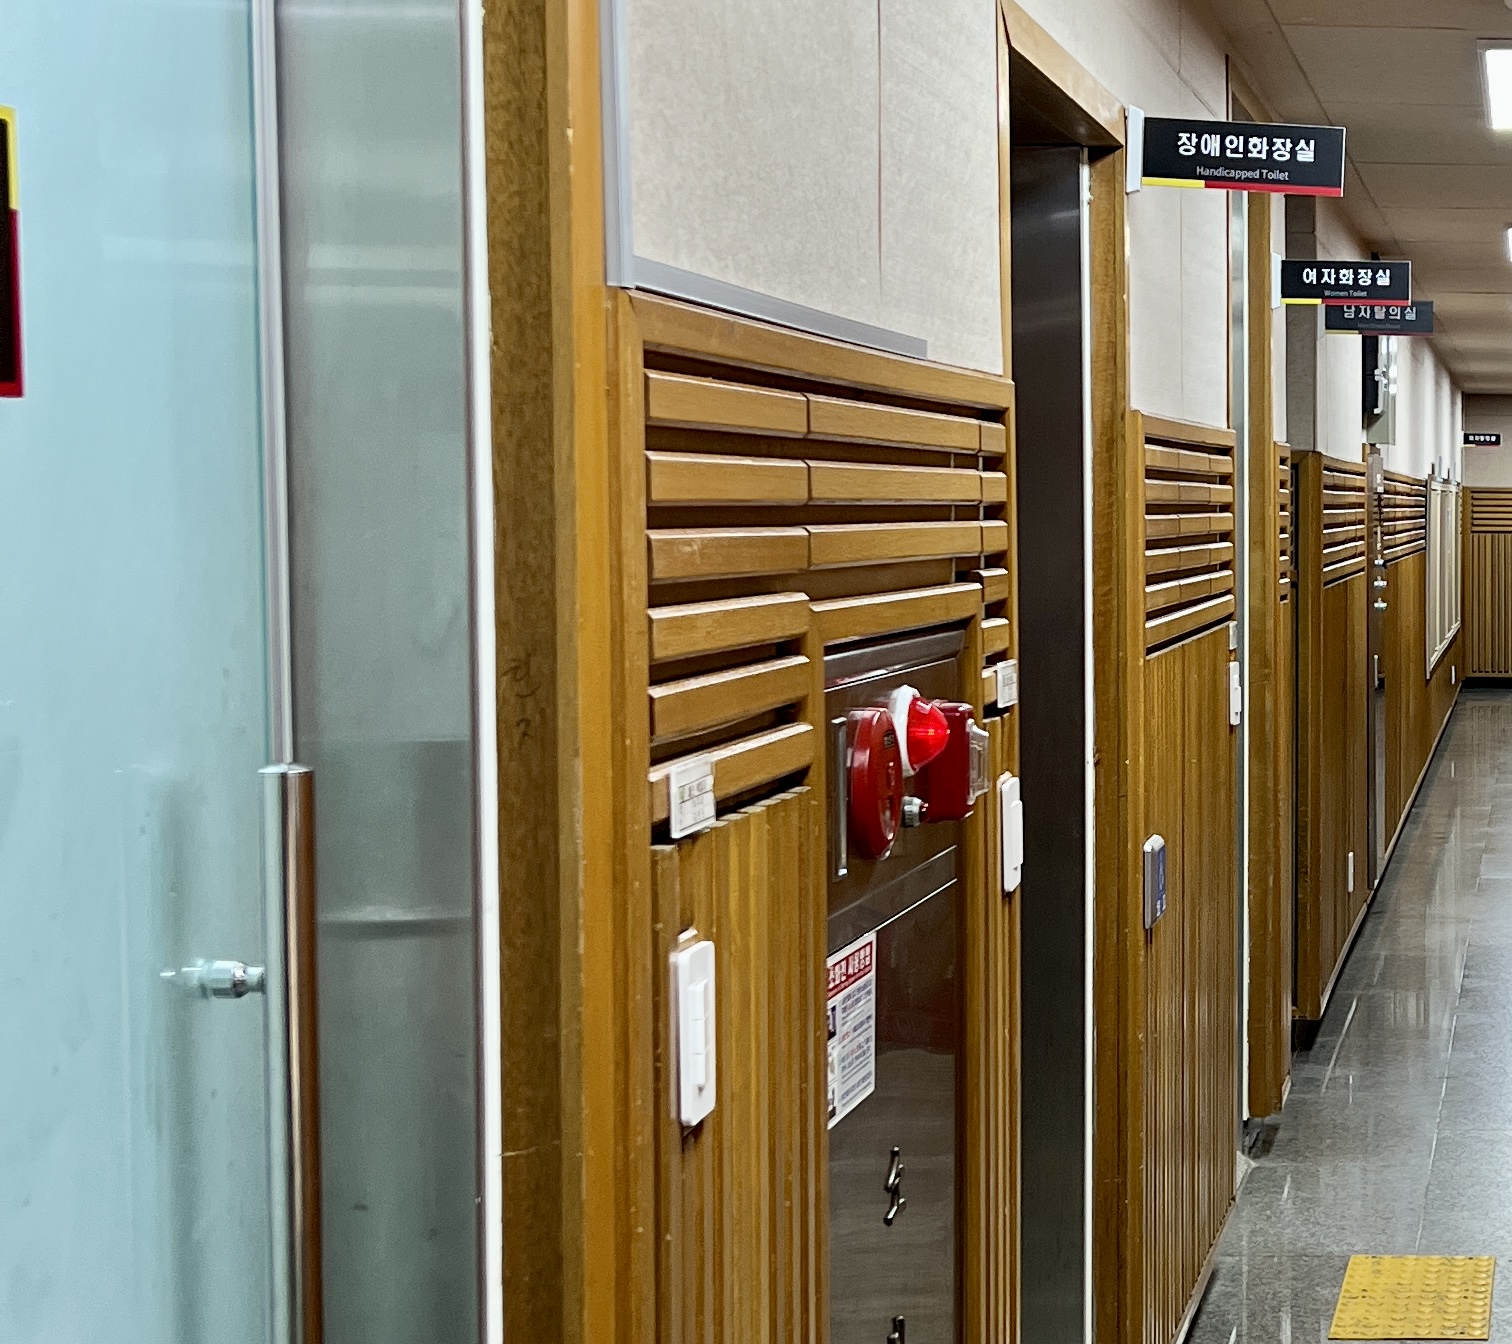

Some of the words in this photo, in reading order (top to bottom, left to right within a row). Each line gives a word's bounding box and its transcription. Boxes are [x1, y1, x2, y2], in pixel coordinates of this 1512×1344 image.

[1177, 132, 1316, 163] 장애인화장실
[1196, 166, 1260, 180] Handicapped
[1261, 169, 1289, 181] Toilet
[1303, 267, 1391, 286] 여자화장실
[1343, 305, 1417, 321] 남자탈의실
